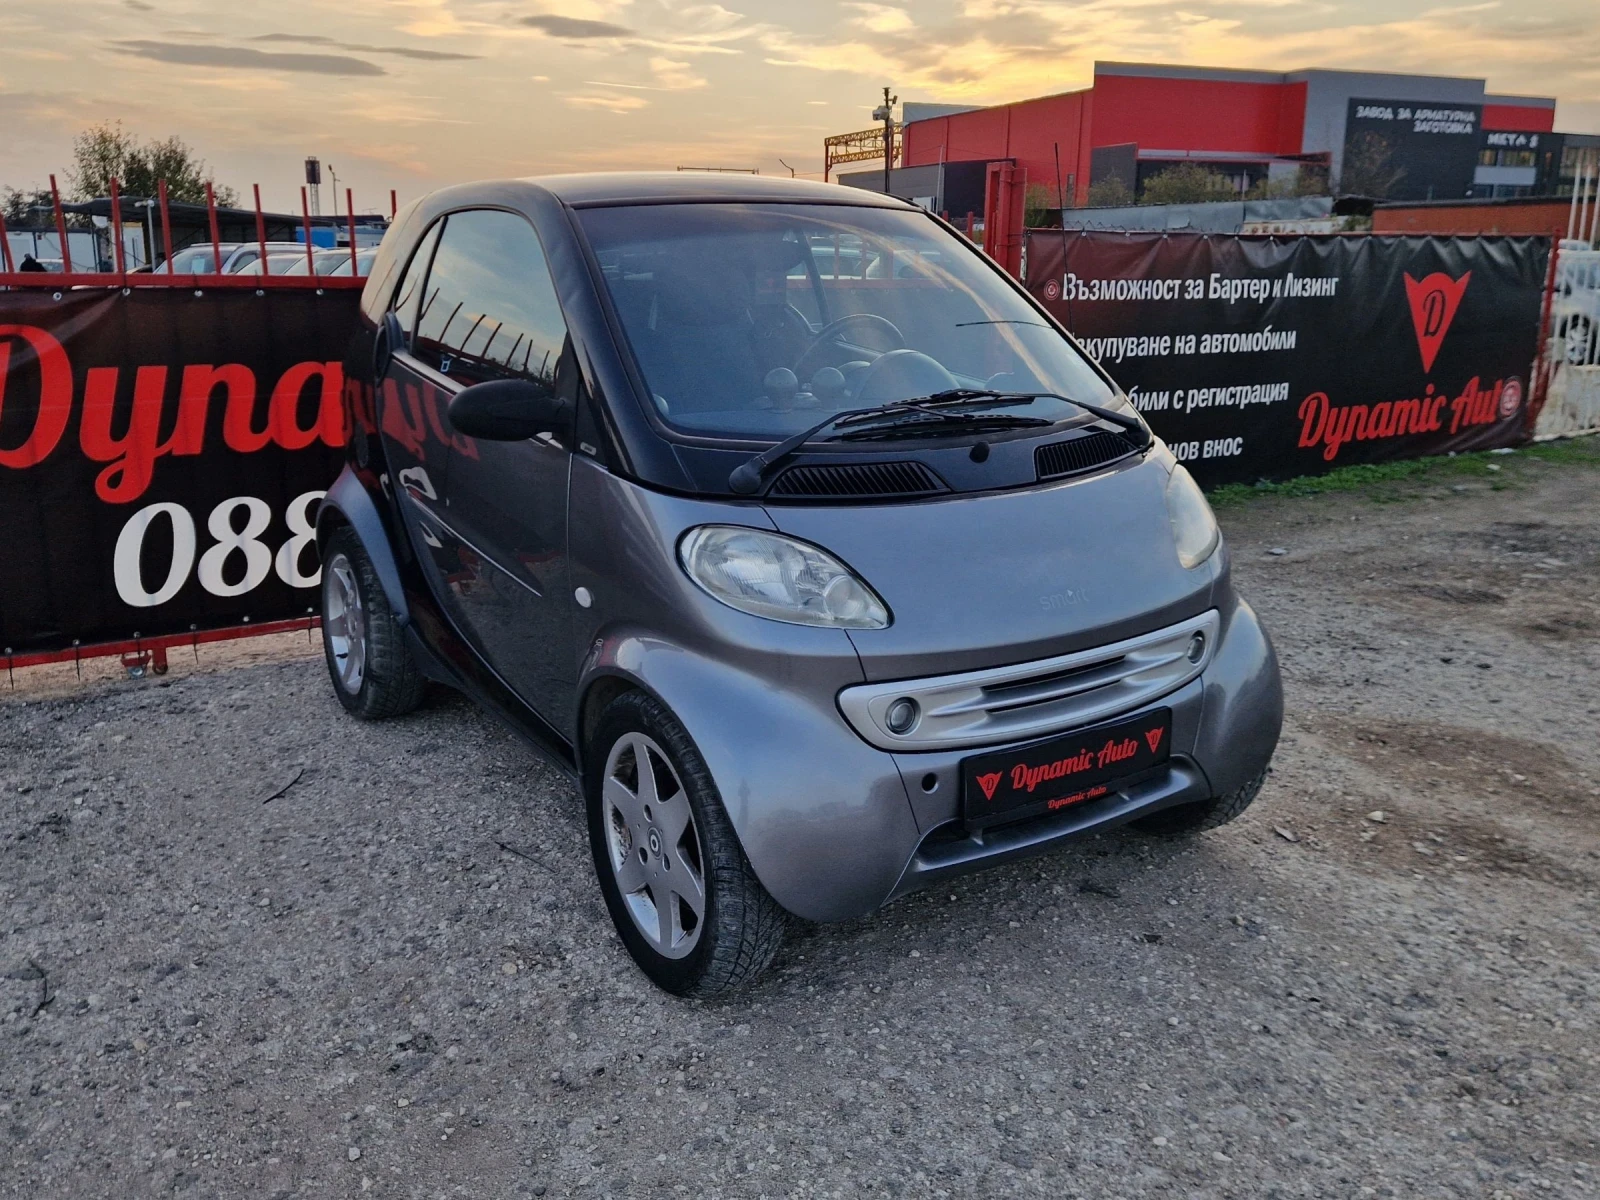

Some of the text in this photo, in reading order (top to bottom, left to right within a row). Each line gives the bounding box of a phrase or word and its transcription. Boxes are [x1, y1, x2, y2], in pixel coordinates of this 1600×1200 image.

[1356, 105, 1394, 120] ЗАВОД
[1396, 107, 1412, 120] ЗА
[1063, 272, 1339, 304] Възможност за Бартер и Лизинг
[1174, 334, 1197, 355] на
[1200, 325, 1297, 354] автомобили
[1173, 389, 1184, 410] с
[1186, 382, 1290, 413] регистрация
[1298, 375, 1522, 461] Dynamic Aut
[1202, 437, 1243, 459] внос
[1010, 748, 1094, 793] Dynamic
[1097, 738, 1138, 769] Auto
[1047, 786, 1107, 810] Dynamic Auto
